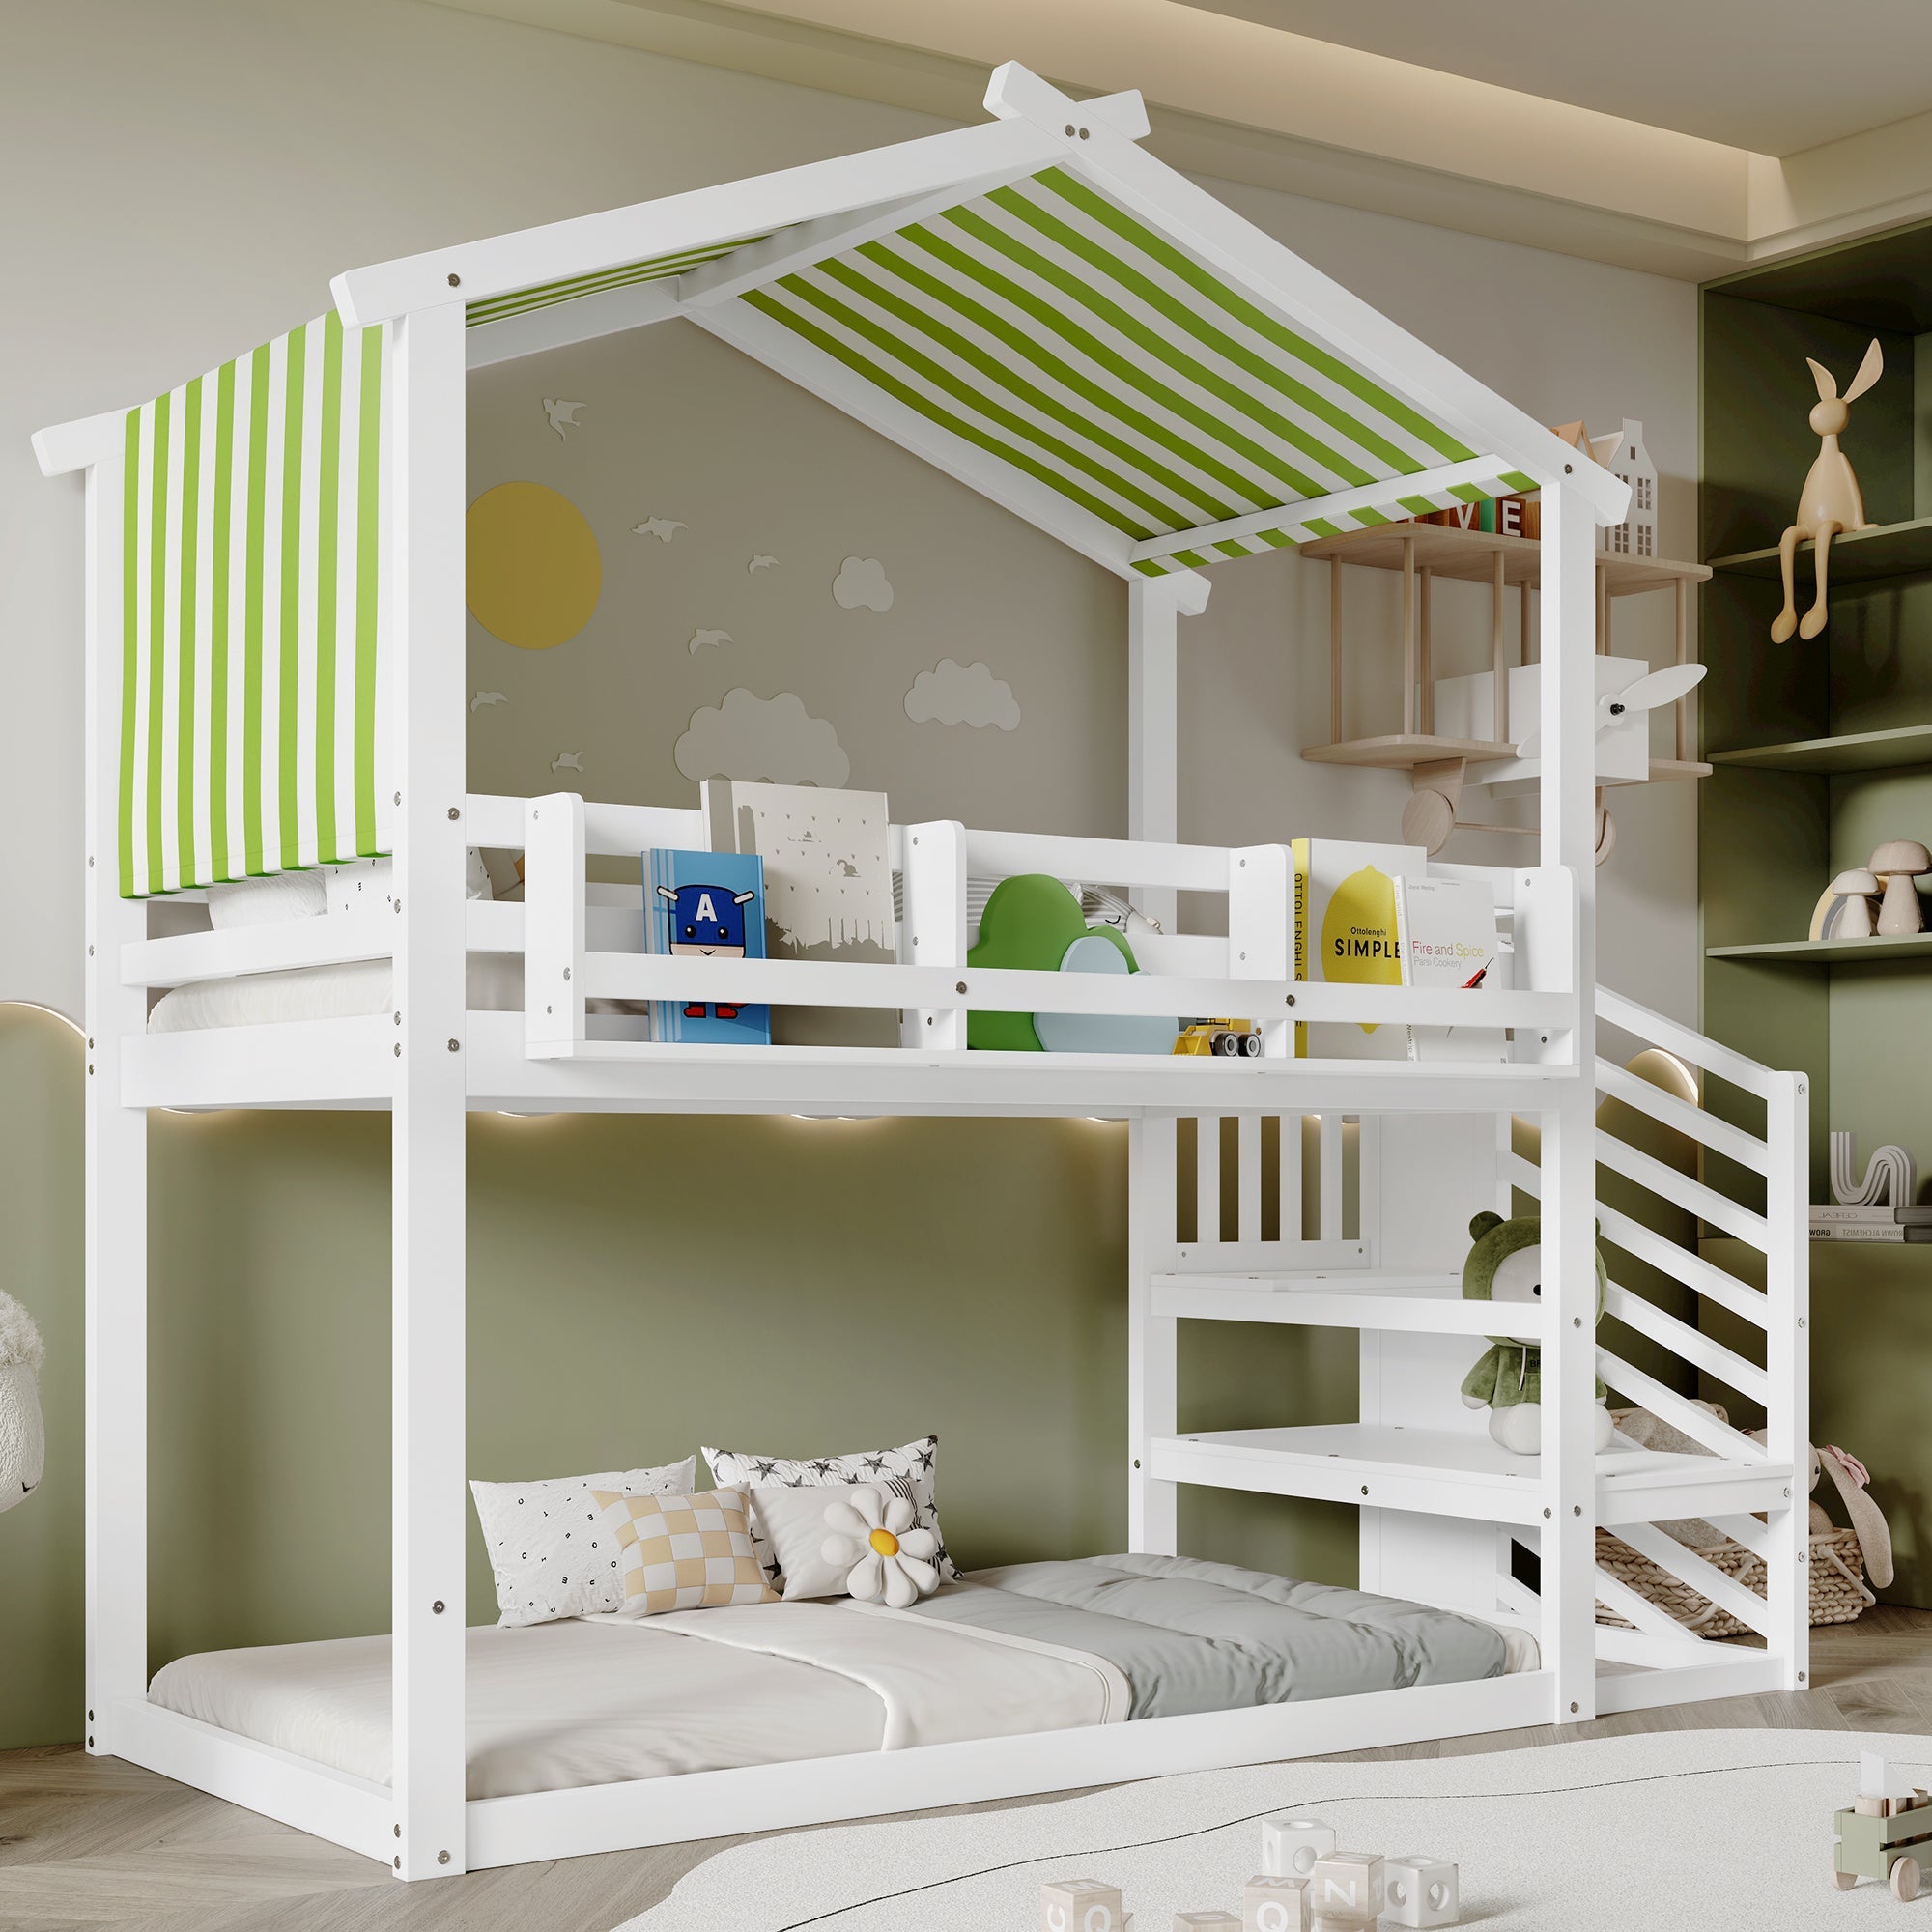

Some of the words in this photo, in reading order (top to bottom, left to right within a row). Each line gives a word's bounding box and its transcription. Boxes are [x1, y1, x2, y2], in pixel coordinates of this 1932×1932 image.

[695, 893, 718, 922] A
[1350, 926, 1387, 938] Ottolenghi
[1335, 938, 1401, 959] SIMPLE
[1412, 941, 1433, 955] Fire
[1435, 942, 1454, 956] and
[1455, 942, 1485, 959] Spice
[1413, 955, 1433, 967] Parsi
[1433, 956, 1462, 969] Cookery
[1324, 1878, 1356, 1908] N
[1256, 1901, 1289, 1932] Q
